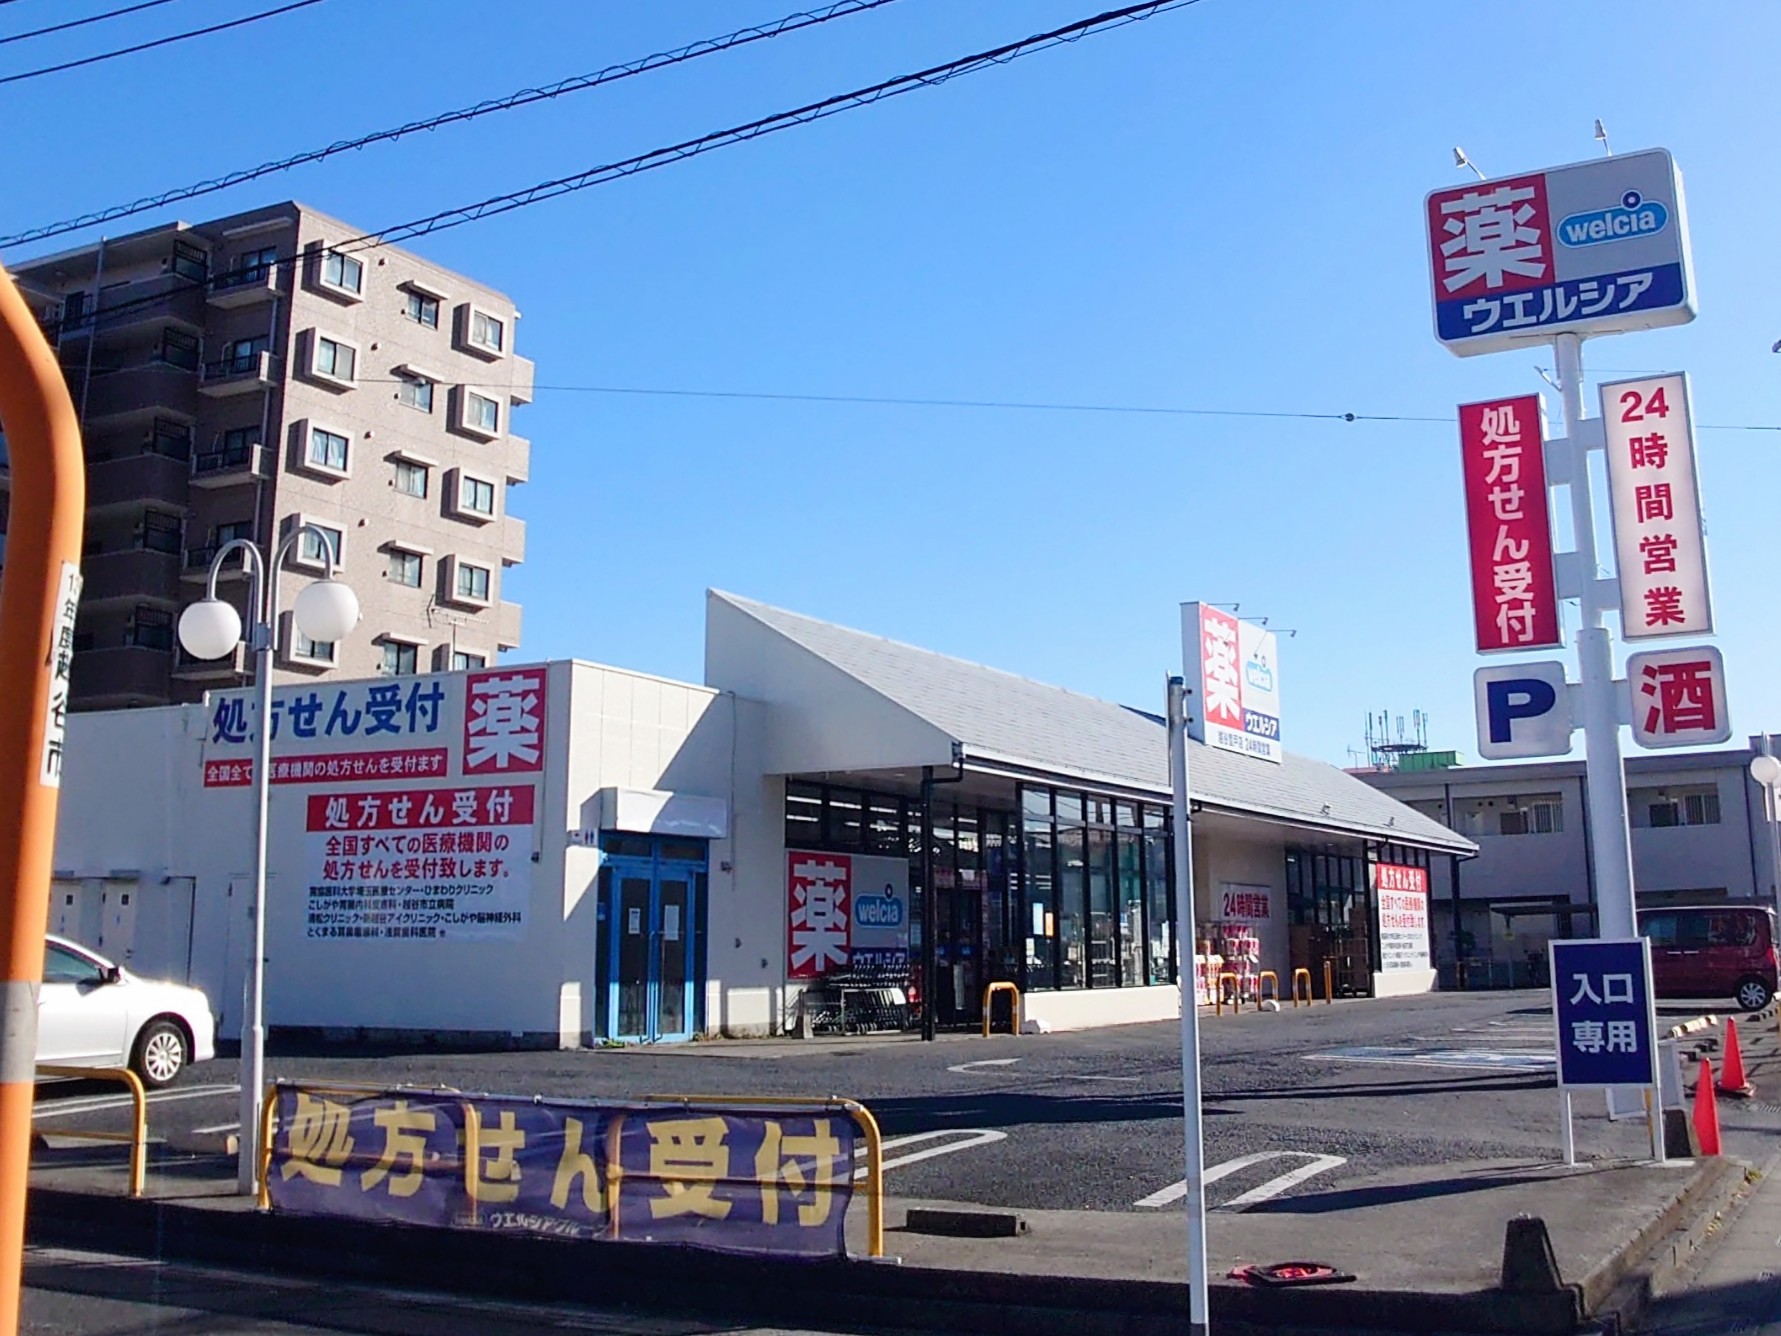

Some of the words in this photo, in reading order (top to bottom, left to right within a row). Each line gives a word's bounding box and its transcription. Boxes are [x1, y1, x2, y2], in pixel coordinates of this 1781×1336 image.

[1439, 186, 1547, 293] 薬
[1566, 207, 1657, 244] welcia
[1462, 272, 1653, 333] ウエルシア
[1480, 404, 1536, 644] 処方せん受付
[1619, 386, 1686, 627] 24時間営業
[1204, 617, 1241, 721] 薬
[1640, 660, 1717, 734] 酒
[467, 675, 540, 769] 薬
[1486, 678, 1556, 743] P
[206, 754, 443, 782] 全国全て医療機関の処方せんを受付ます
[325, 789, 514, 829] 処方せん受付
[323, 857, 509, 881] 処方せんを受付致します。
[325, 831, 510, 857] 全国すべての医療機関の
[791, 860, 848, 972] 薬
[857, 898, 899, 923] welcia
[1569, 973, 1634, 1005] 入口
[1571, 1020, 1637, 1054] 専用
[280, 1092, 840, 1227] 処方せん受付
